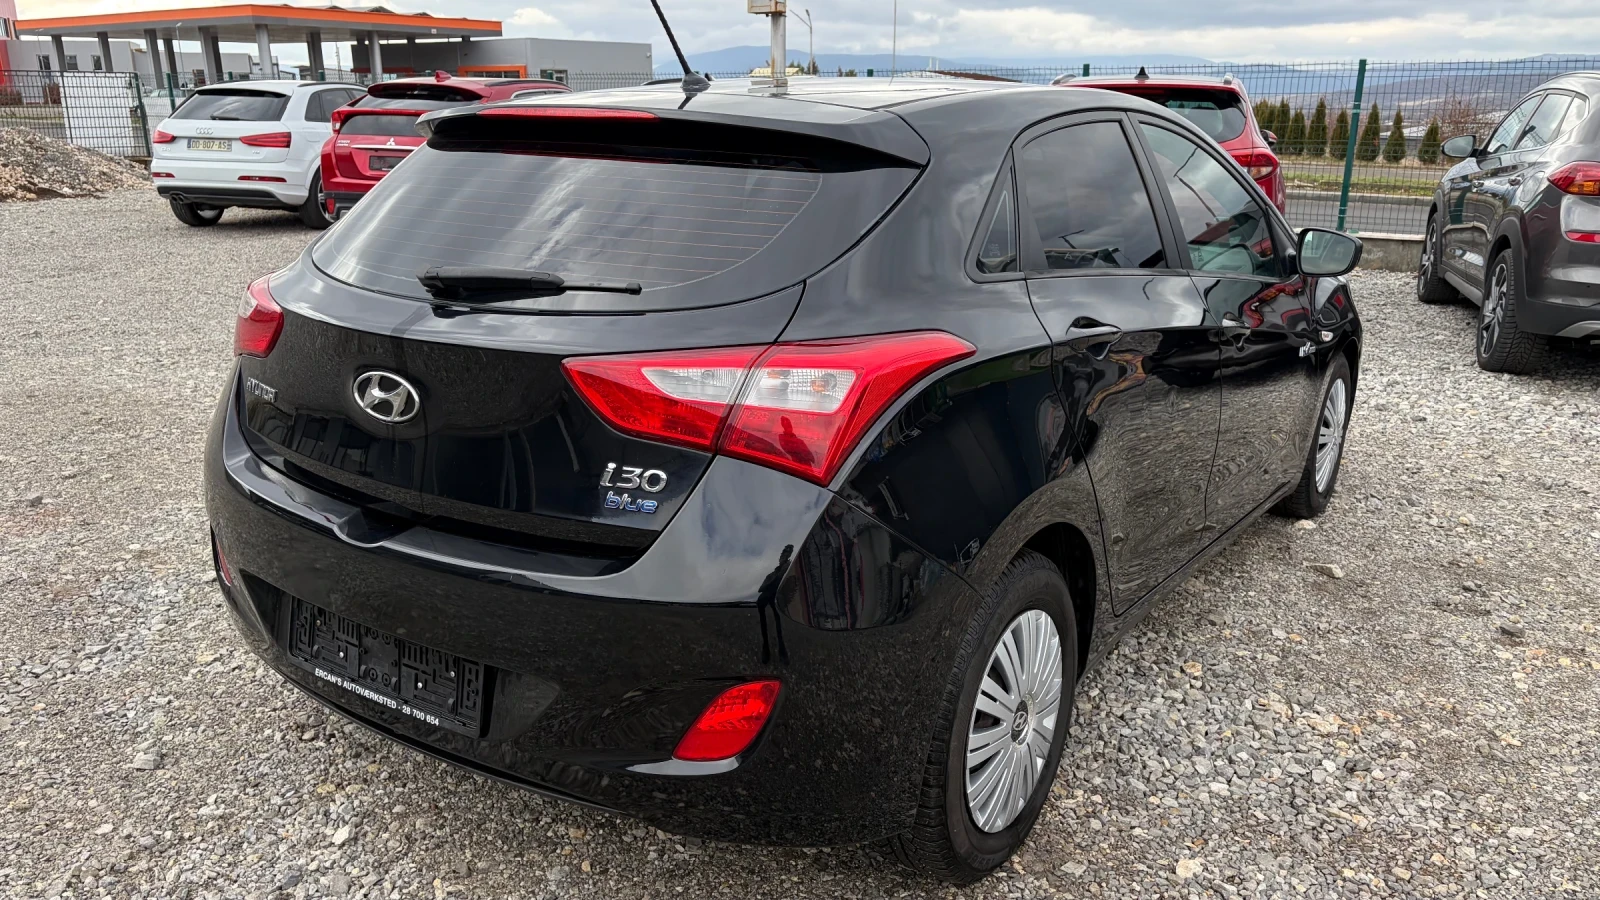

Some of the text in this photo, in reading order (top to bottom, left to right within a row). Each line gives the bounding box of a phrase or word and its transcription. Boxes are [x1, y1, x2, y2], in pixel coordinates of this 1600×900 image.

[600, 462, 667, 492] i30
[604, 490, 658, 513] blue
[315, 667, 342, 686] ERCAN'S
[343, 680, 397, 709] AUTOVÆRKSTED
[402, 705, 411, 715] 28
[412, 711, 425, 720] 700
[426, 715, 439, 726] 654
